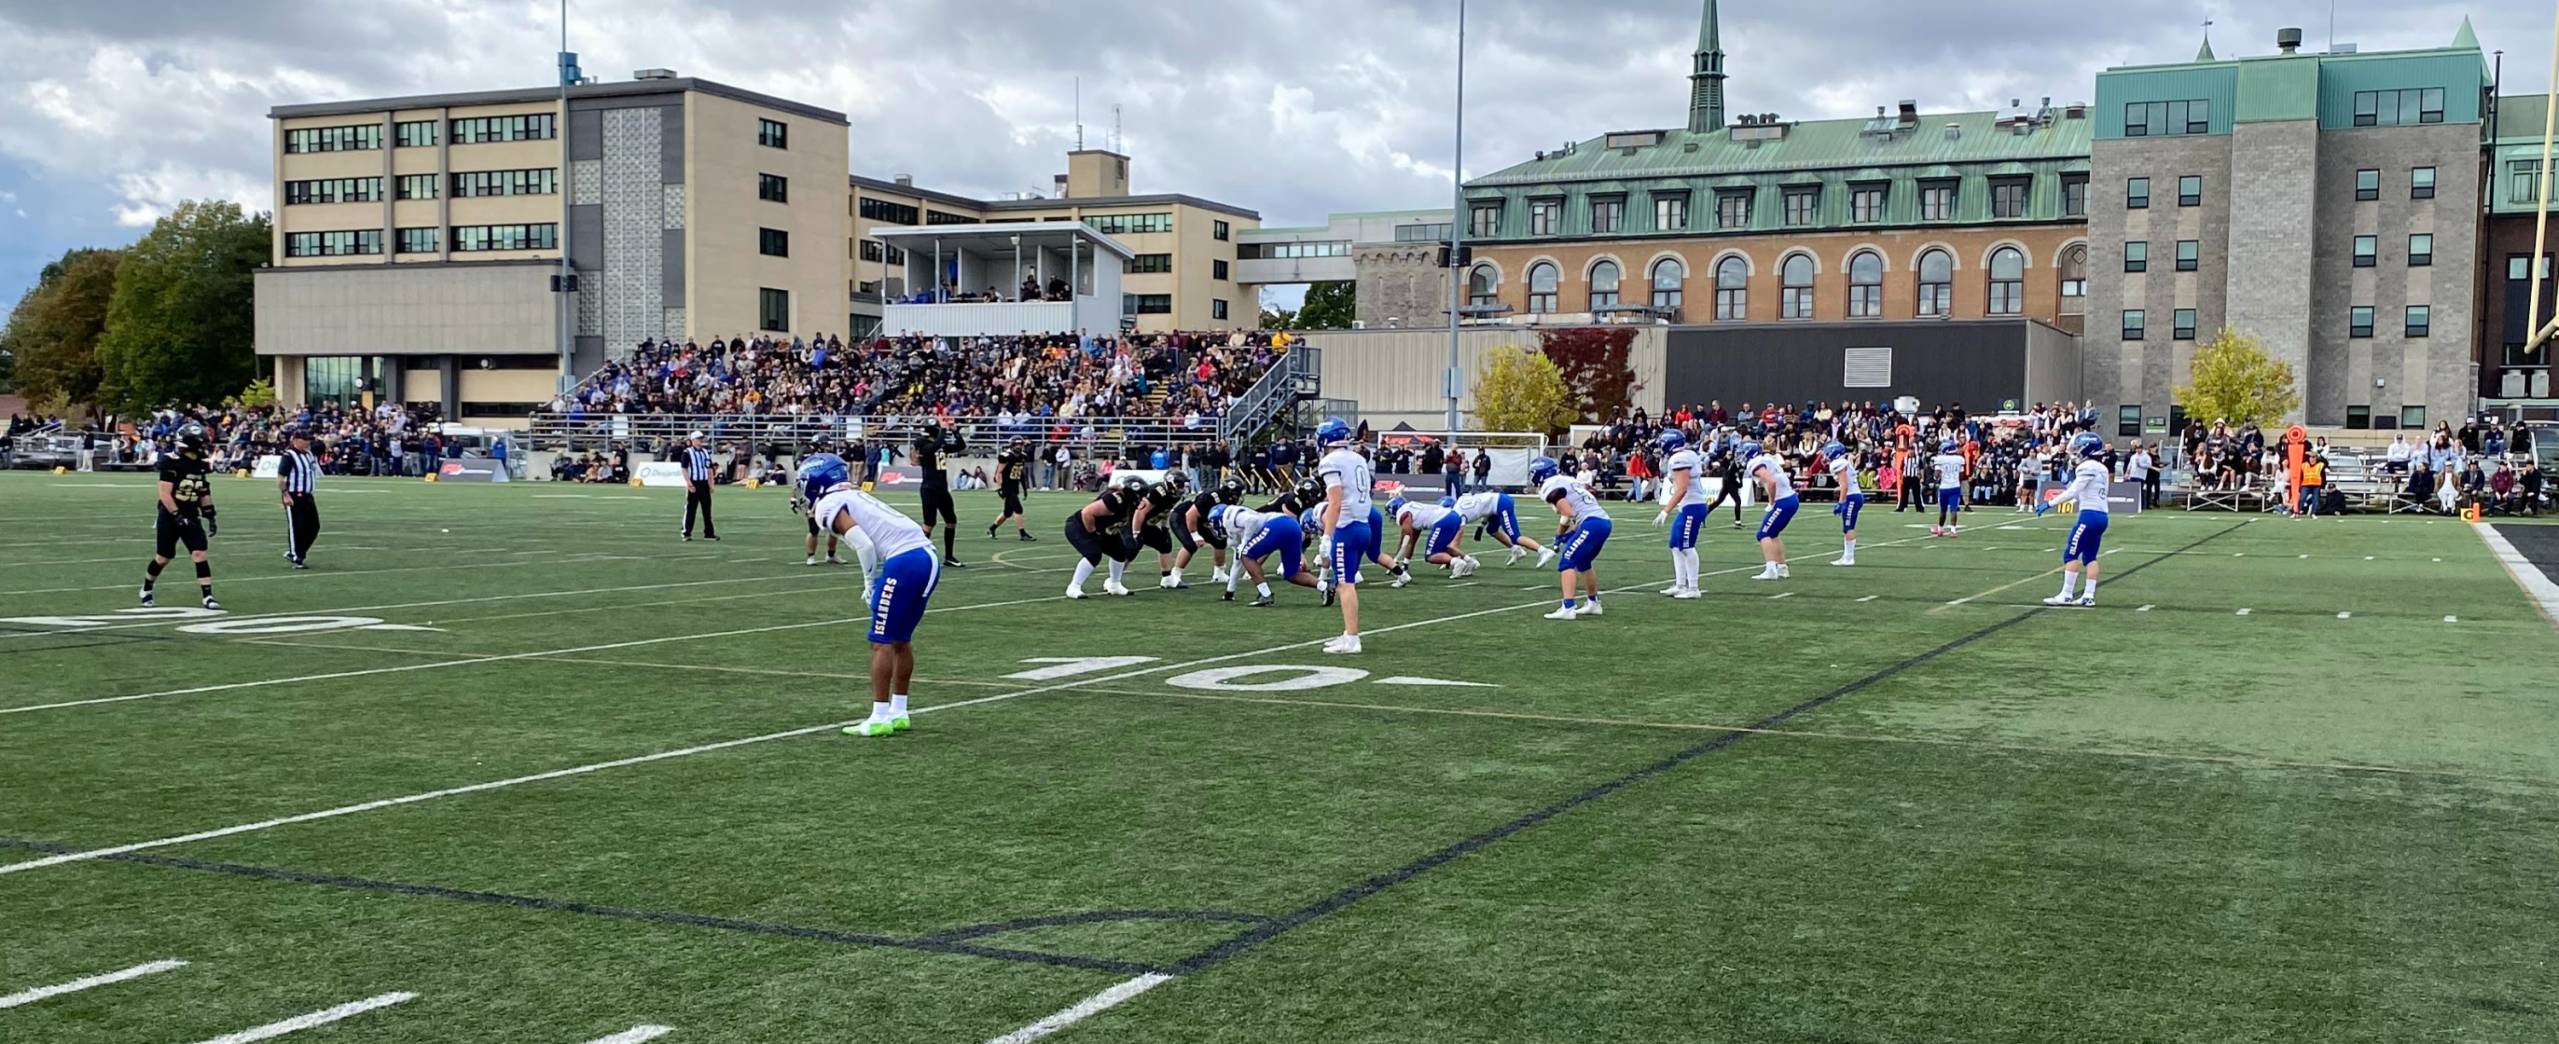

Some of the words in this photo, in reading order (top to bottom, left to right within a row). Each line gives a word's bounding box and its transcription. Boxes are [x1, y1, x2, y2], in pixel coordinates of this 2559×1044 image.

[934, 452, 947, 471] 12
[1336, 542, 1346, 583] SLANDERS
[874, 577, 898, 636] ISLANDERS
[998, 655, 1370, 691] 10
